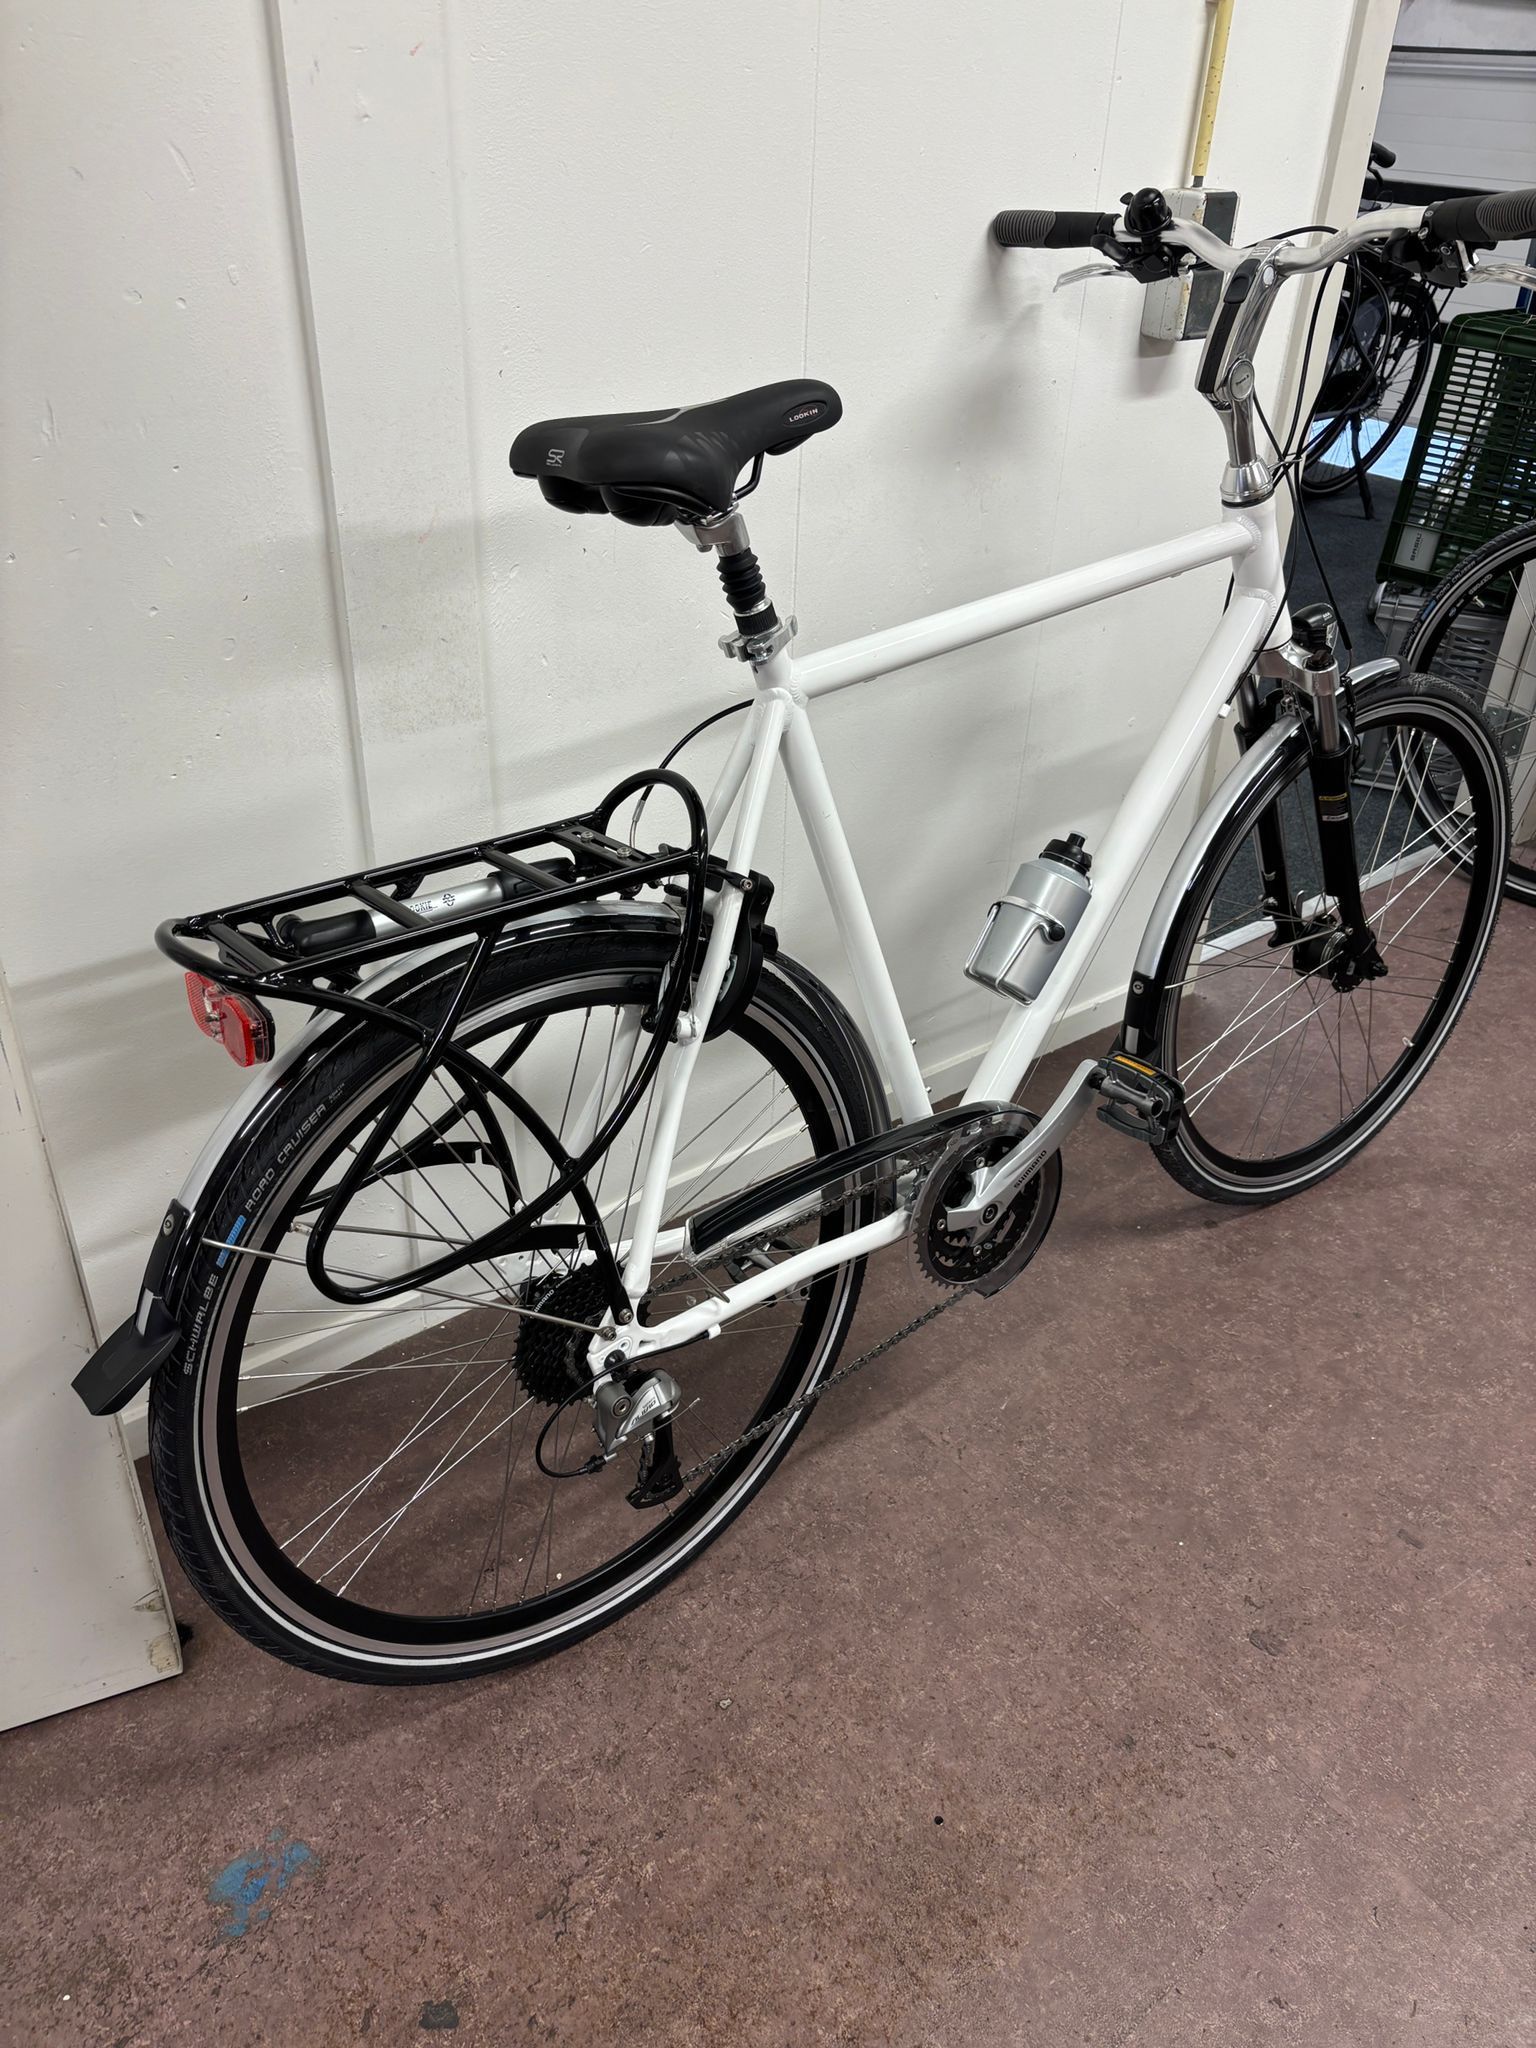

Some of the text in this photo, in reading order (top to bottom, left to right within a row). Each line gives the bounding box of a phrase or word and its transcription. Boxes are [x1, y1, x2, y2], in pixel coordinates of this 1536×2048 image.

[789, 408, 819, 423] LOOKIN
[1013, 1150, 1047, 1189] SHIMANO
[183, 1103, 327, 1376] SCHWALBE ROAD CRUISER
[534, 1289, 555, 1313] HIMANO
